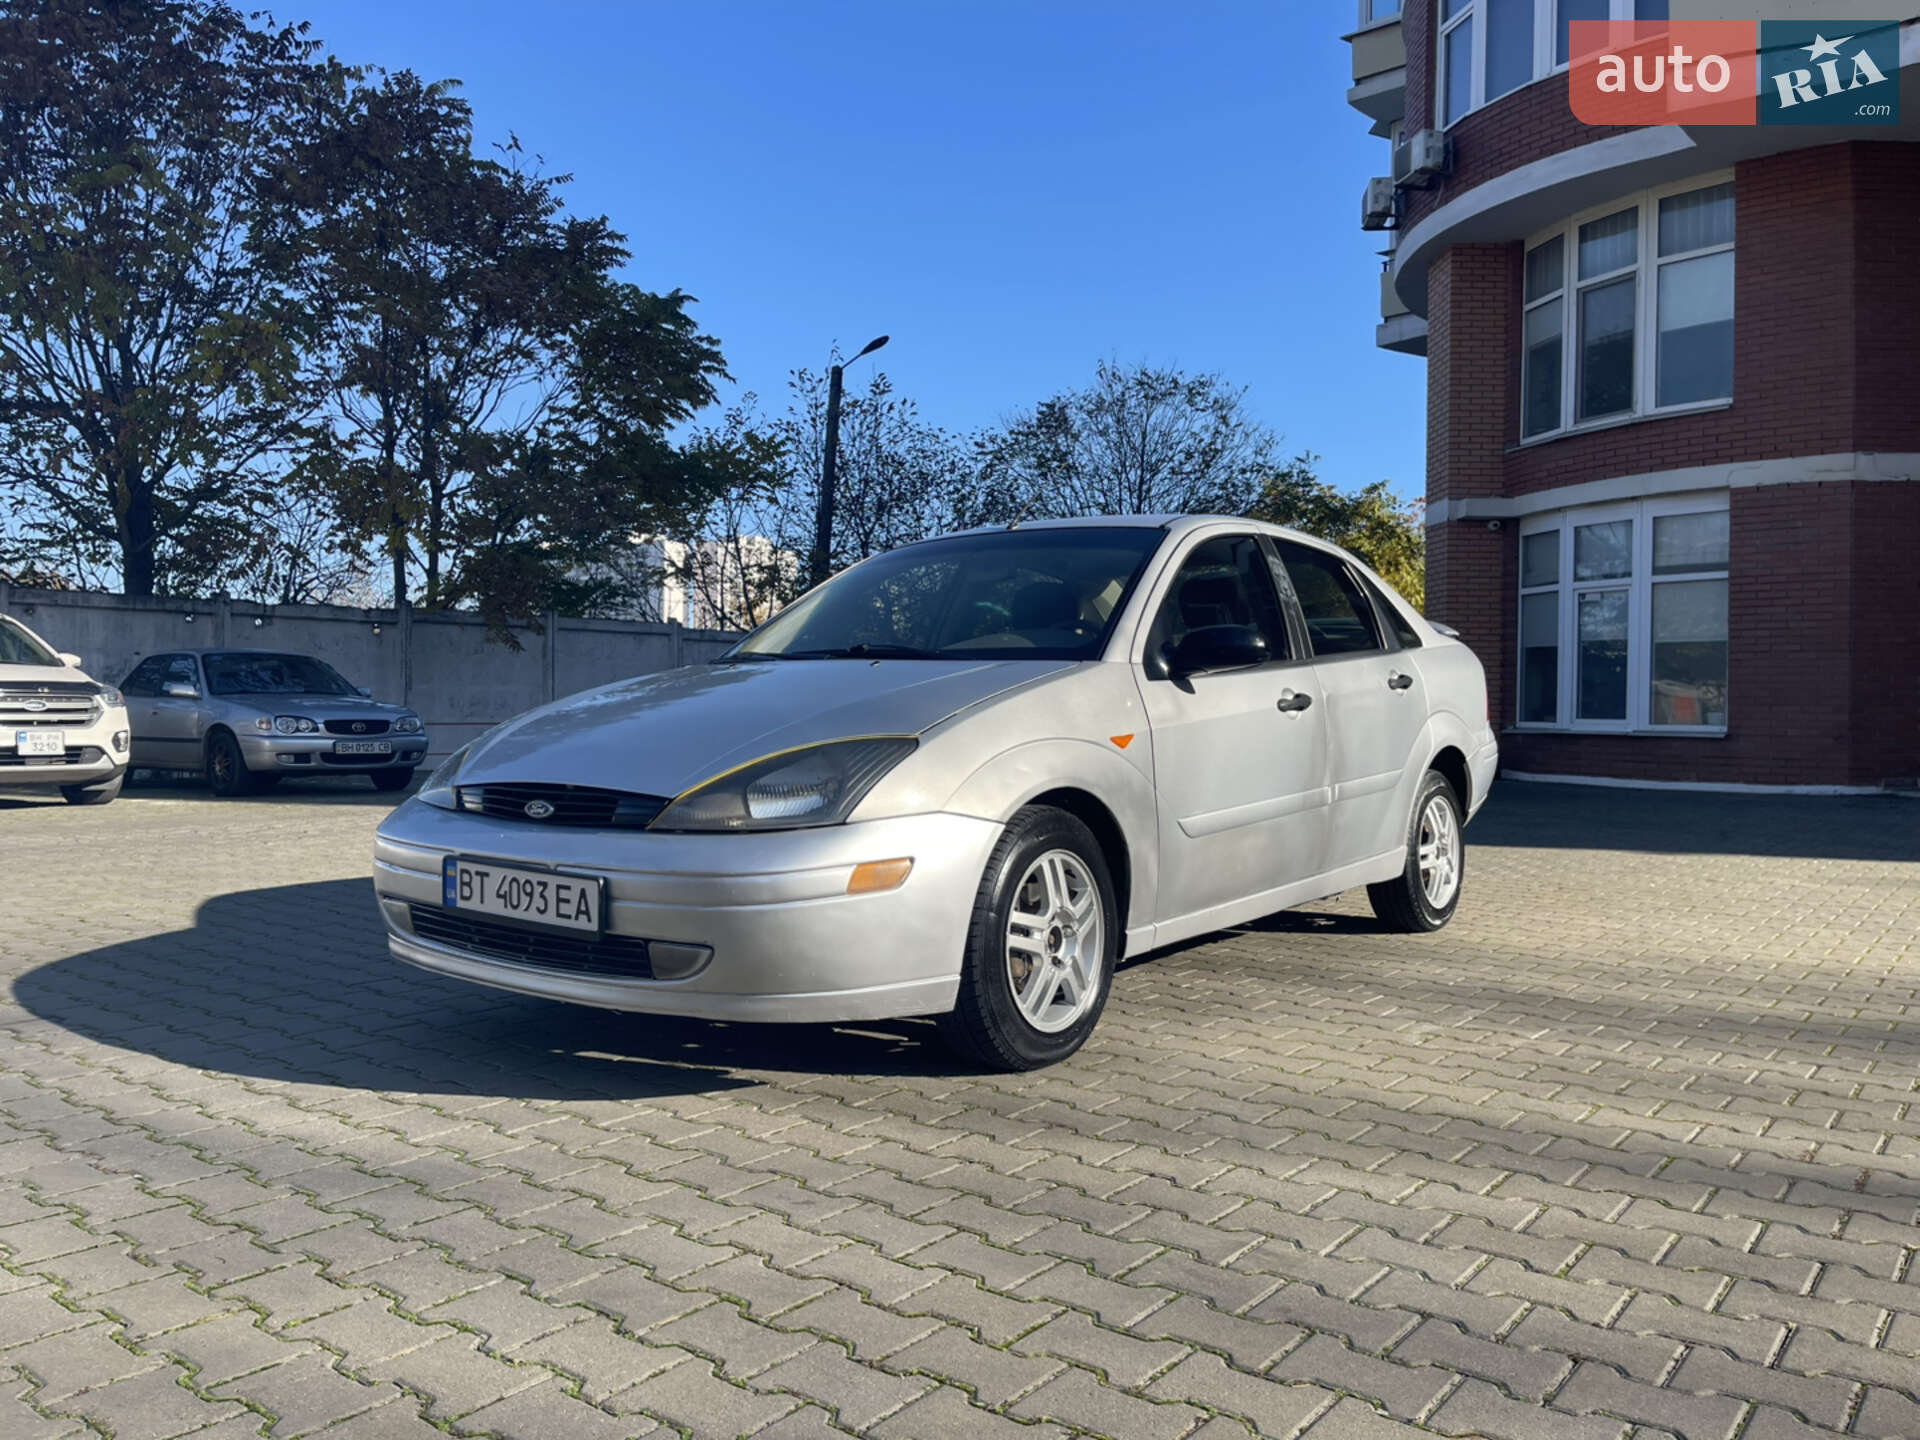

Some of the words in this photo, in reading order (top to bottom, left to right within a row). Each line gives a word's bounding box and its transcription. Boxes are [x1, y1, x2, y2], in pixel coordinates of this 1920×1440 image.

[459, 868, 490, 904] BT
[496, 875, 548, 915] 4093
[556, 884, 592, 923] EA
